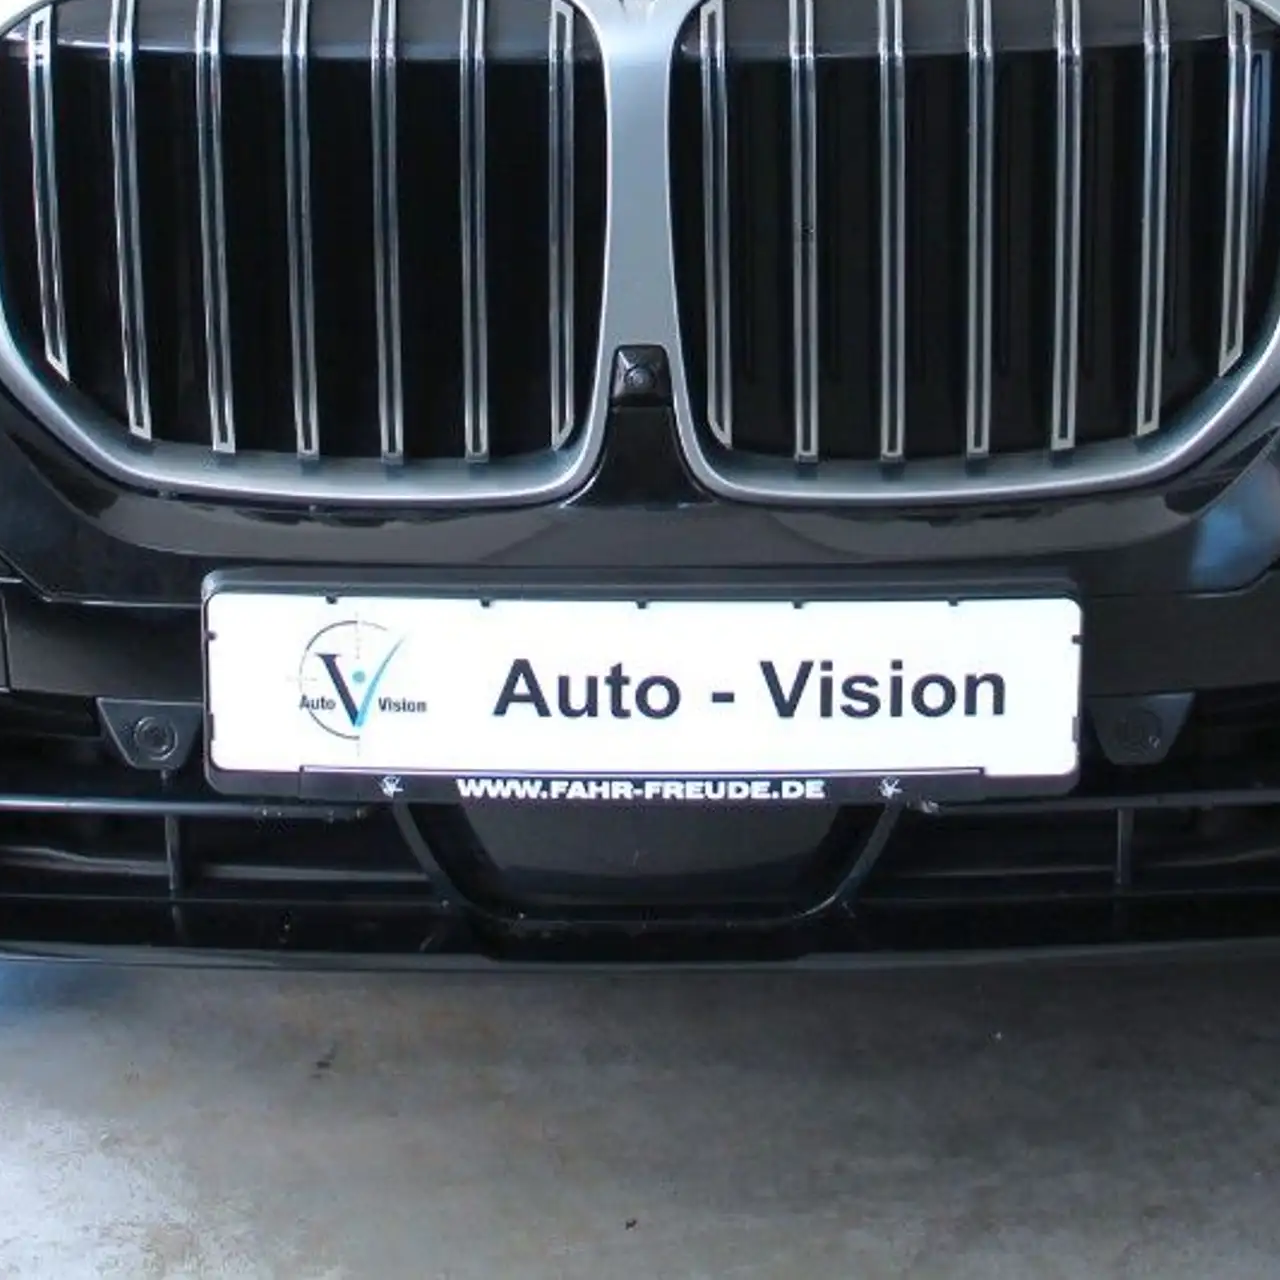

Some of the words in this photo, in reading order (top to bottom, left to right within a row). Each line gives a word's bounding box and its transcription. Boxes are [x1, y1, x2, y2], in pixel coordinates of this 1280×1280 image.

[493, 658, 681, 719] Auto
[760, 659, 1007, 719] Vision
[299, 694, 336, 710] Auto
[378, 697, 428, 713] Vision
[456, 778, 826, 800] WWW.FAHR-FREUDE.DE
